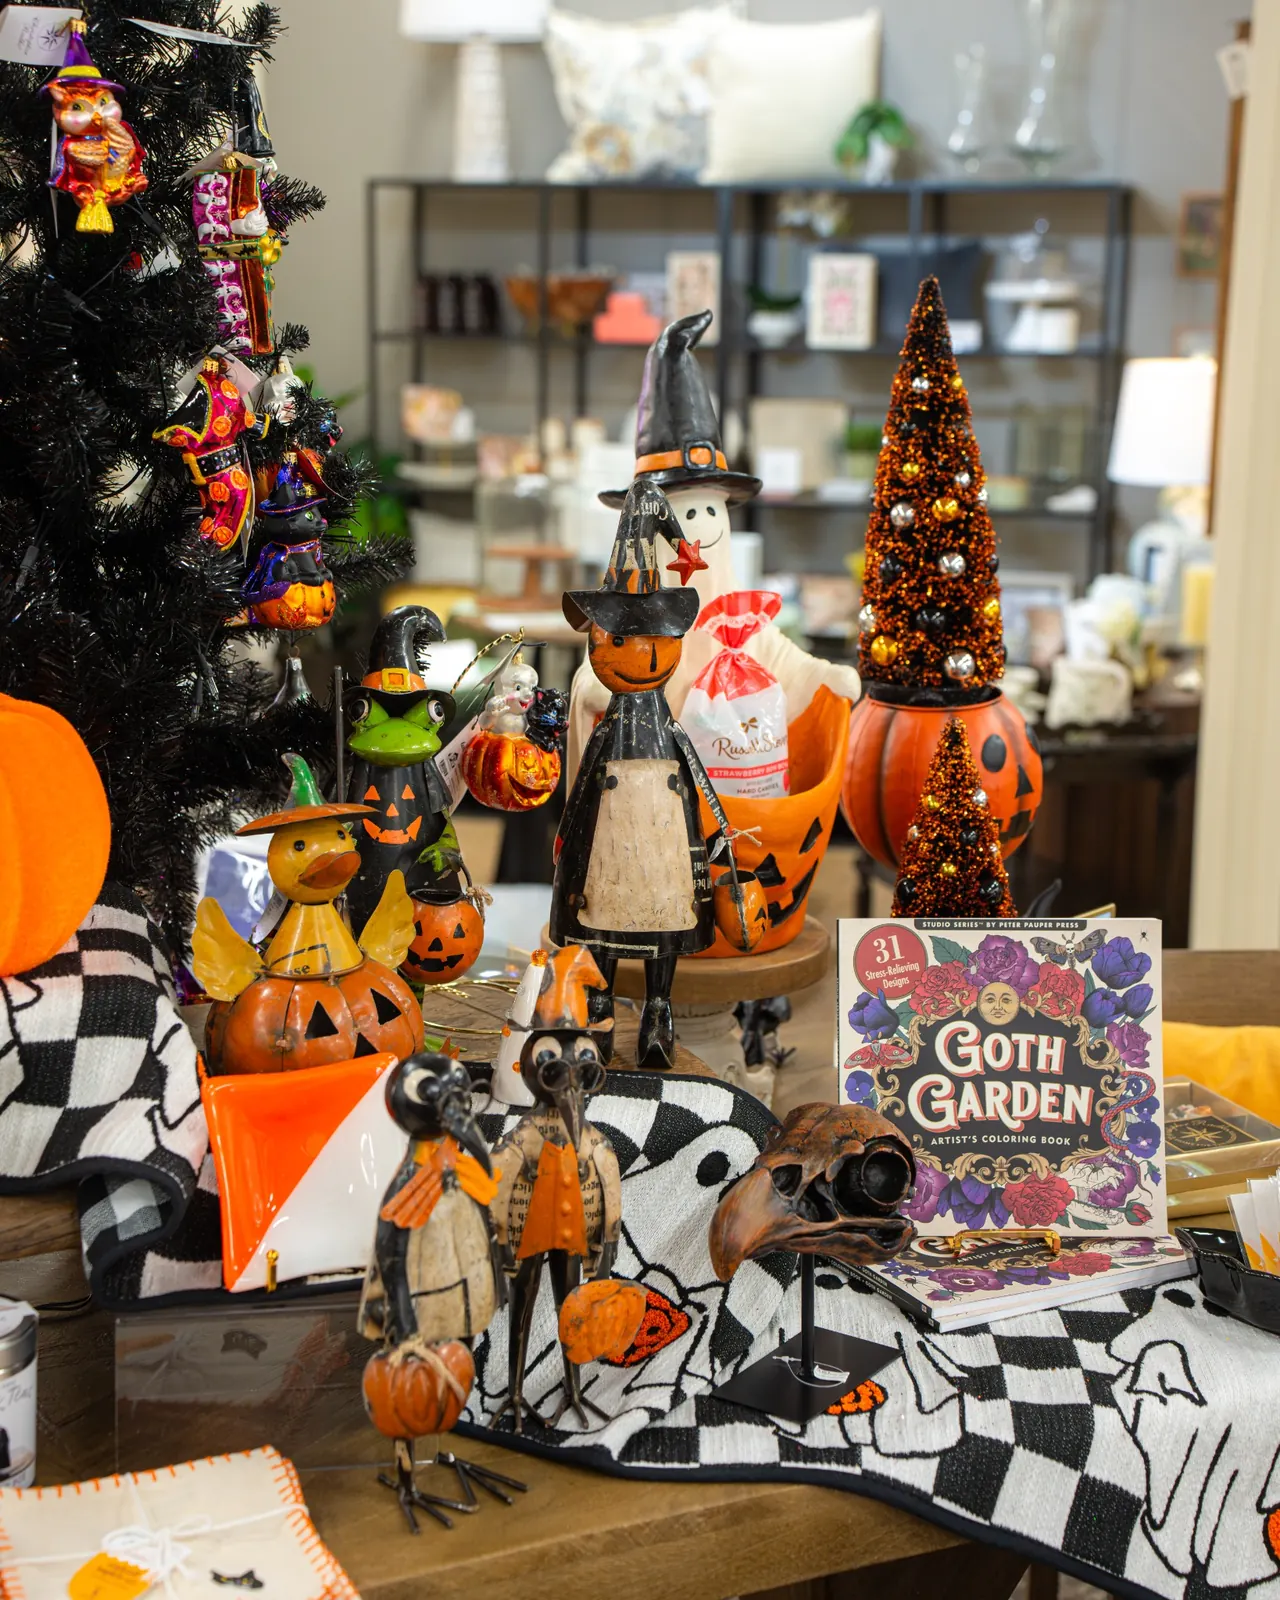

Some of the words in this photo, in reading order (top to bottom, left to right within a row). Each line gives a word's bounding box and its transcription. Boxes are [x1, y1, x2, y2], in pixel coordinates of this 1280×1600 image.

[873, 935, 905, 964] 31
[865, 962, 920, 980] Stress-Relieving
[882, 977, 910, 988] Designs
[935, 1020, 1067, 1078] GOTH
[908, 1073, 1095, 1133] GARDEN
[930, 1135, 978, 1146] ARTIST'S
[981, 1135, 1037, 1144] COLORING
[1041, 1136, 1071, 1146] BOOK
